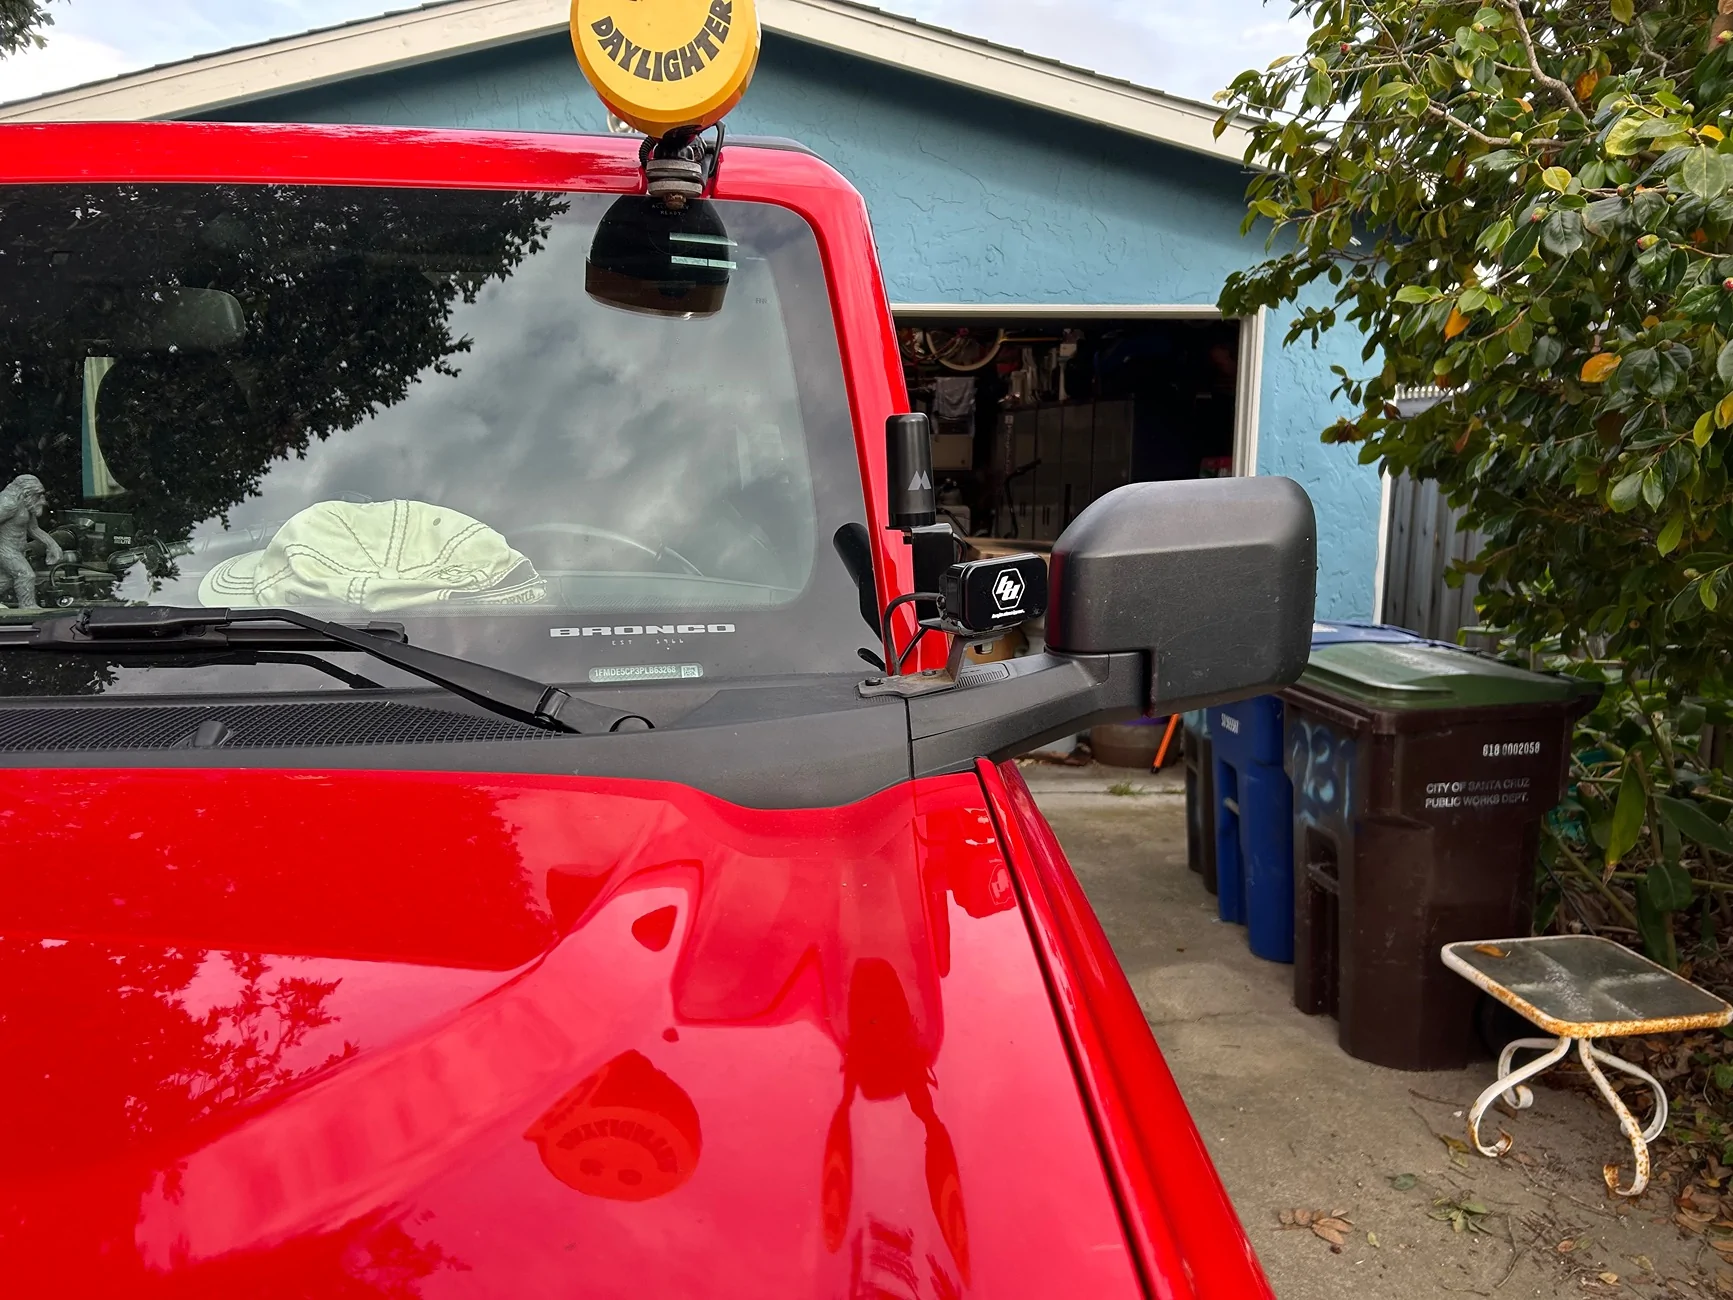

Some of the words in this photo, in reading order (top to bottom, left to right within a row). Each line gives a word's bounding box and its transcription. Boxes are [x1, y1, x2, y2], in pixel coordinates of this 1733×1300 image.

[591, 0, 732, 82] DAYLIGHTER
[550, 624, 736, 637] BRONCO
[1426, 782, 1451, 794] CITY
[1451, 781, 1466, 793] OF
[1468, 779, 1500, 792] SANTA
[1503, 777, 1530, 790] CRUZ
[1425, 796, 1461, 808] PUBLIC
[1463, 794, 1500, 806] WORKS
